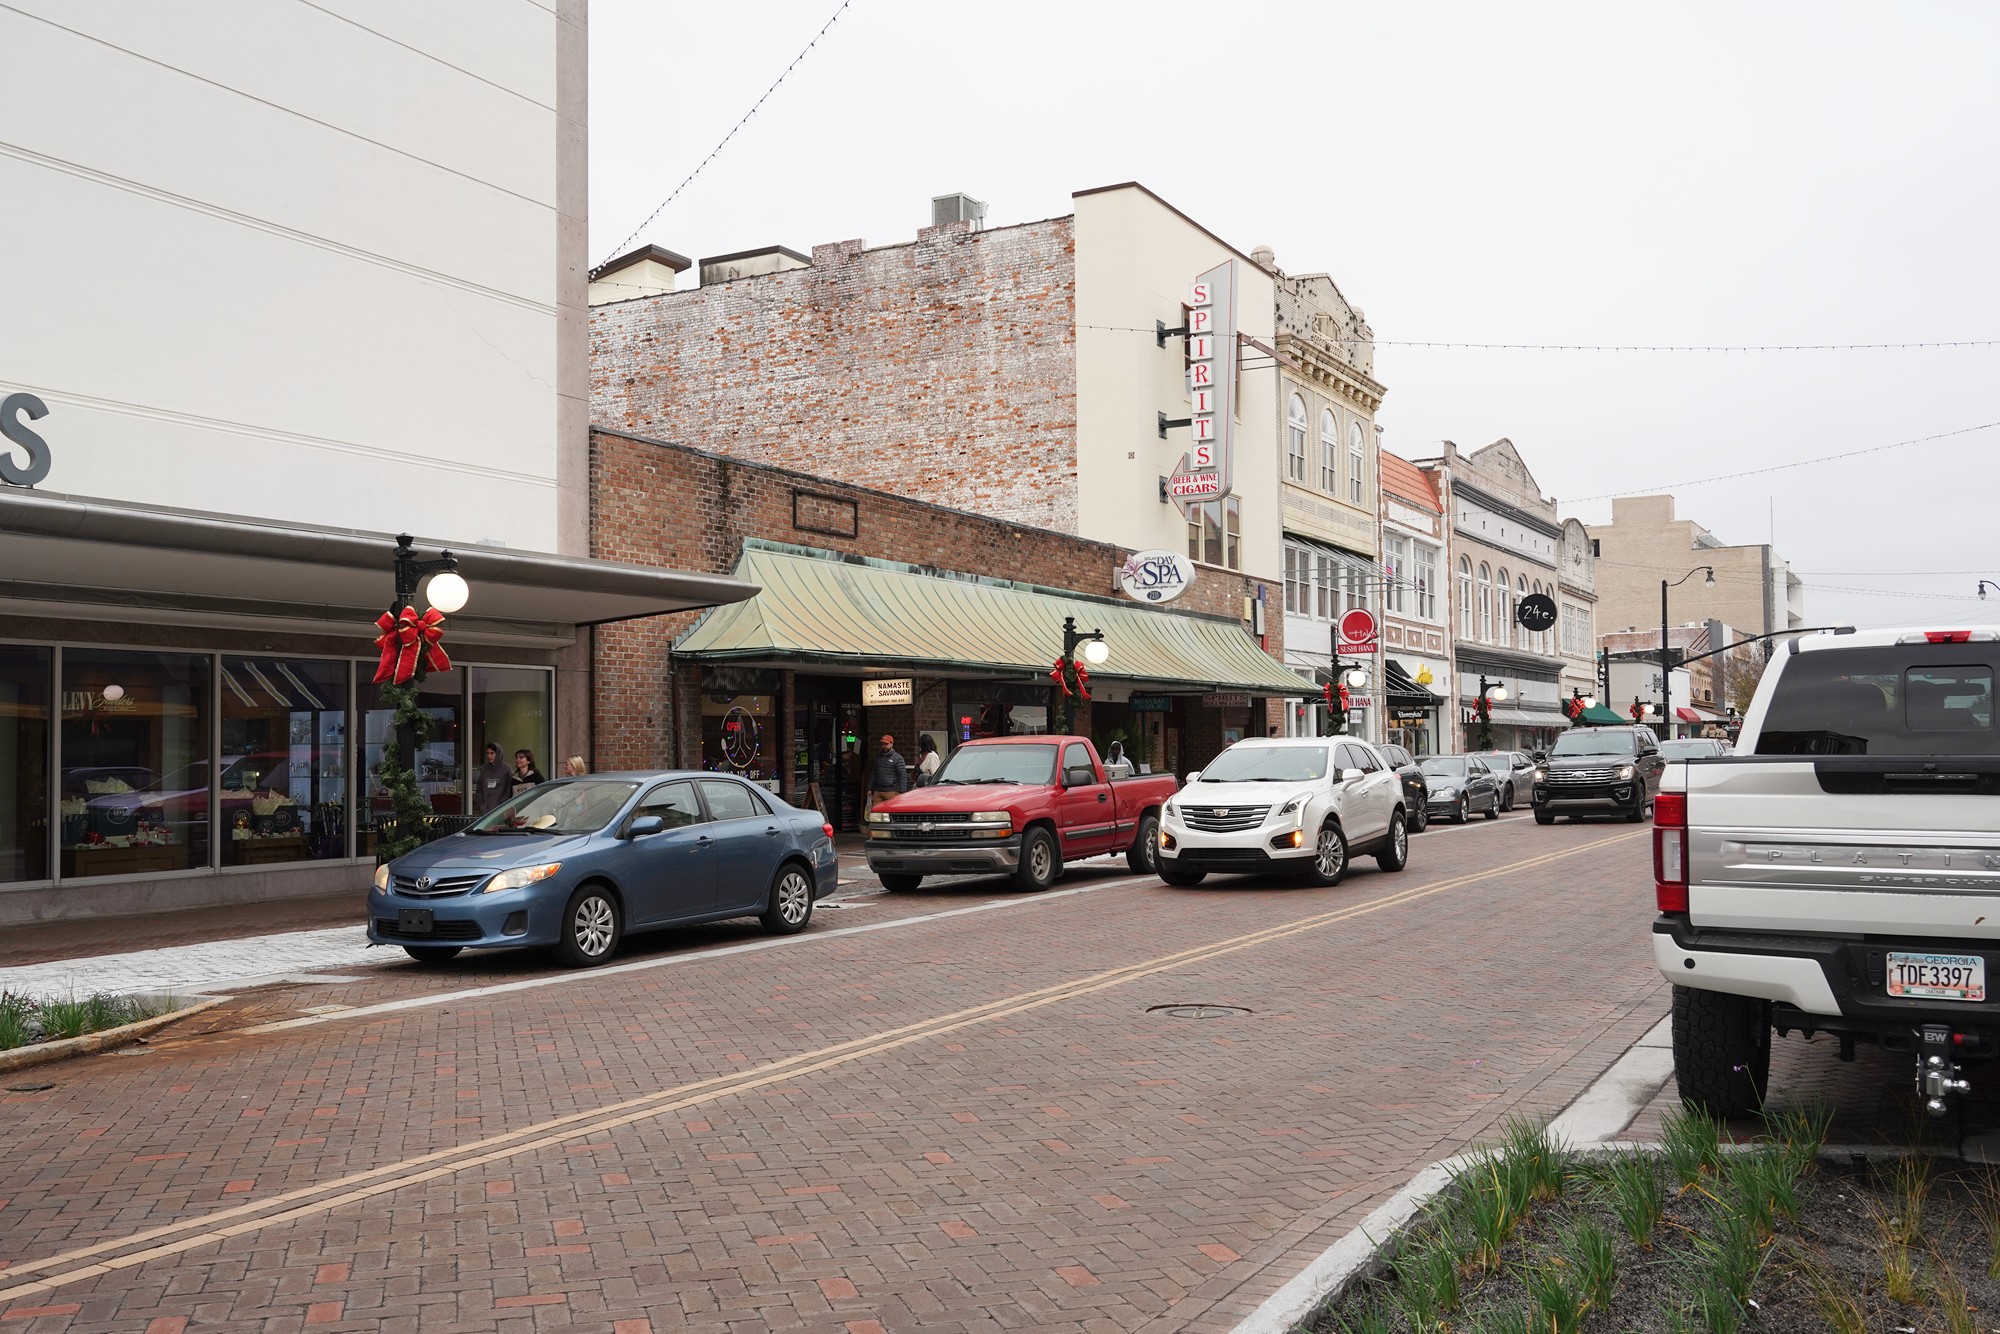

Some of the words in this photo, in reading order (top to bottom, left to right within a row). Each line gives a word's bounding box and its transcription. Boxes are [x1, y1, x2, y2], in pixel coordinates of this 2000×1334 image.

[1193, 285, 1210, 465] SPIRITS
[1173, 476, 1190, 485] BEER
[1200, 474, 1217, 482] WINE
[1174, 483, 1218, 495] CIGARS
[1156, 556, 1175, 565] DAY
[1143, 561, 1184, 586] SPA
[1340, 645, 1358, 653] SUSHI
[879, 689, 911, 697] SAVANNAH
[63, 691, 95, 711] LEVY
[1356, 698, 1371, 706] HANA
[1924, 956, 1978, 967] GEORGIA
[1896, 964, 1973, 988] TDE3397
